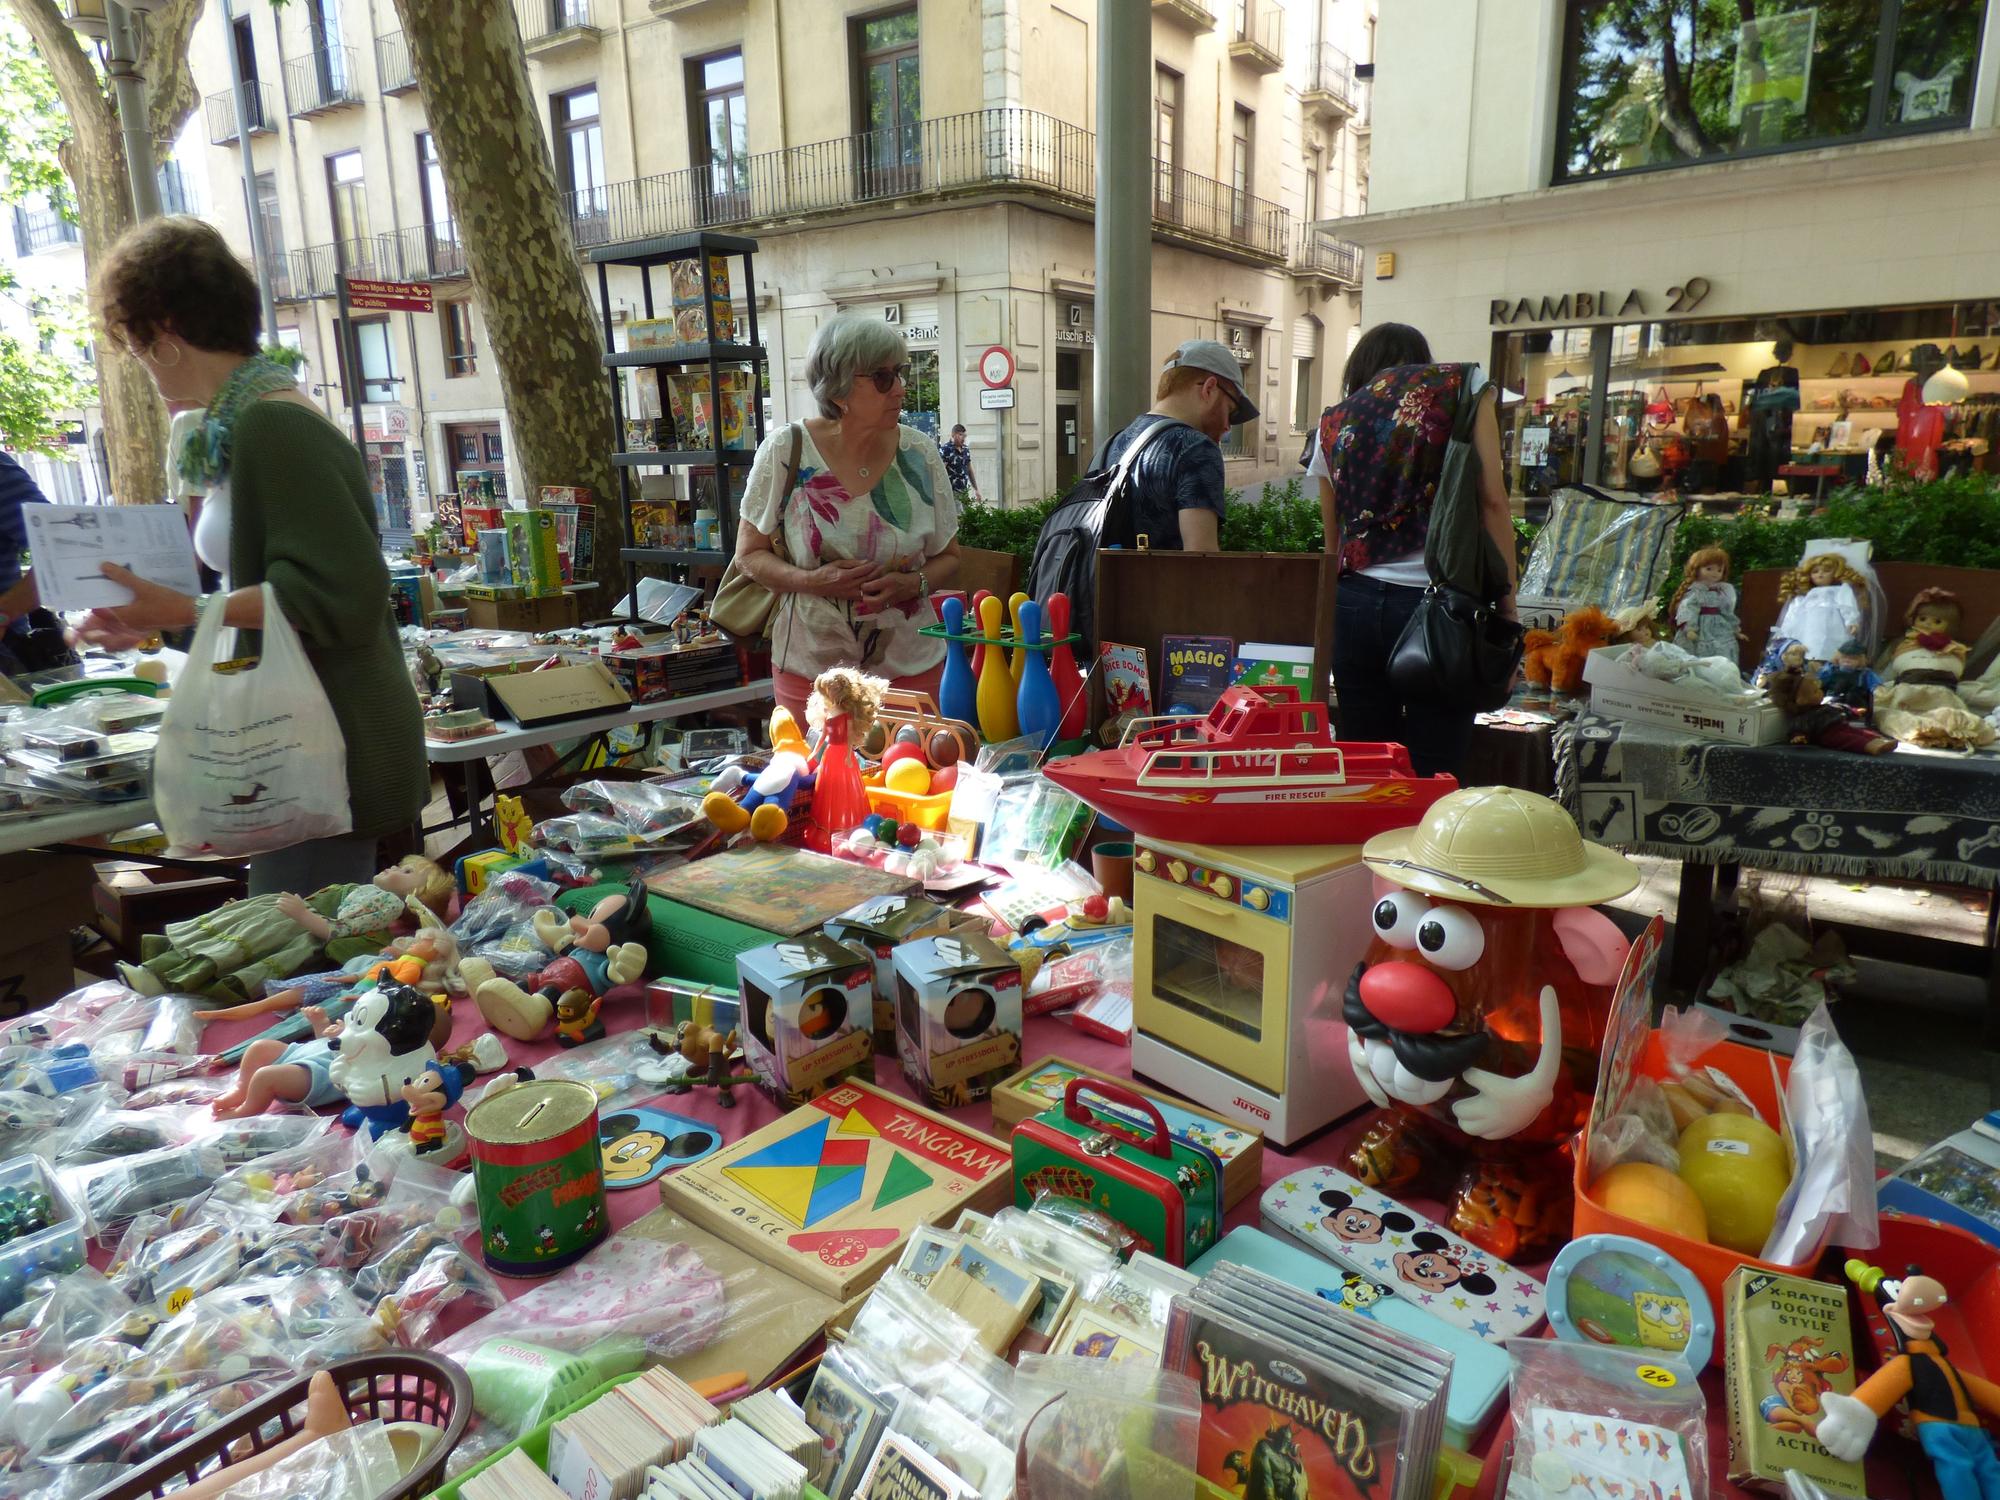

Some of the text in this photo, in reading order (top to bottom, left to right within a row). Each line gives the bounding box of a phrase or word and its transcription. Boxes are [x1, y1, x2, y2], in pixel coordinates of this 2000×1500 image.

[352, 298, 364, 306] WC
[1490, 276, 1711, 325] RAMBLA 29
[908, 325, 940, 340] Bank
[1056, 327, 1083, 343] eutsche
[1104, 660, 1121, 672] DICE
[1169, 649, 1226, 668] MAGIC
[1265, 791, 1327, 801] FIRE RESCUE
[802, 1059, 812, 1073] UP
[945, 1056, 956, 1069] UP
[839, 1089, 858, 1100] 28
[1233, 1096, 1271, 1120] JUYCO
[884, 1114, 1001, 1176] TANGRAM
[949, 1182, 963, 1192] 2+
[820, 1247, 851, 1267] GOULA
[1750, 1277, 1768, 1293] New
[1770, 1287, 1844, 1309] X-RATED
[1771, 1300, 1838, 1322] DOGGIE
[1779, 1314, 1831, 1334] STYLE
[1776, 1435, 1841, 1459] ACTIO
